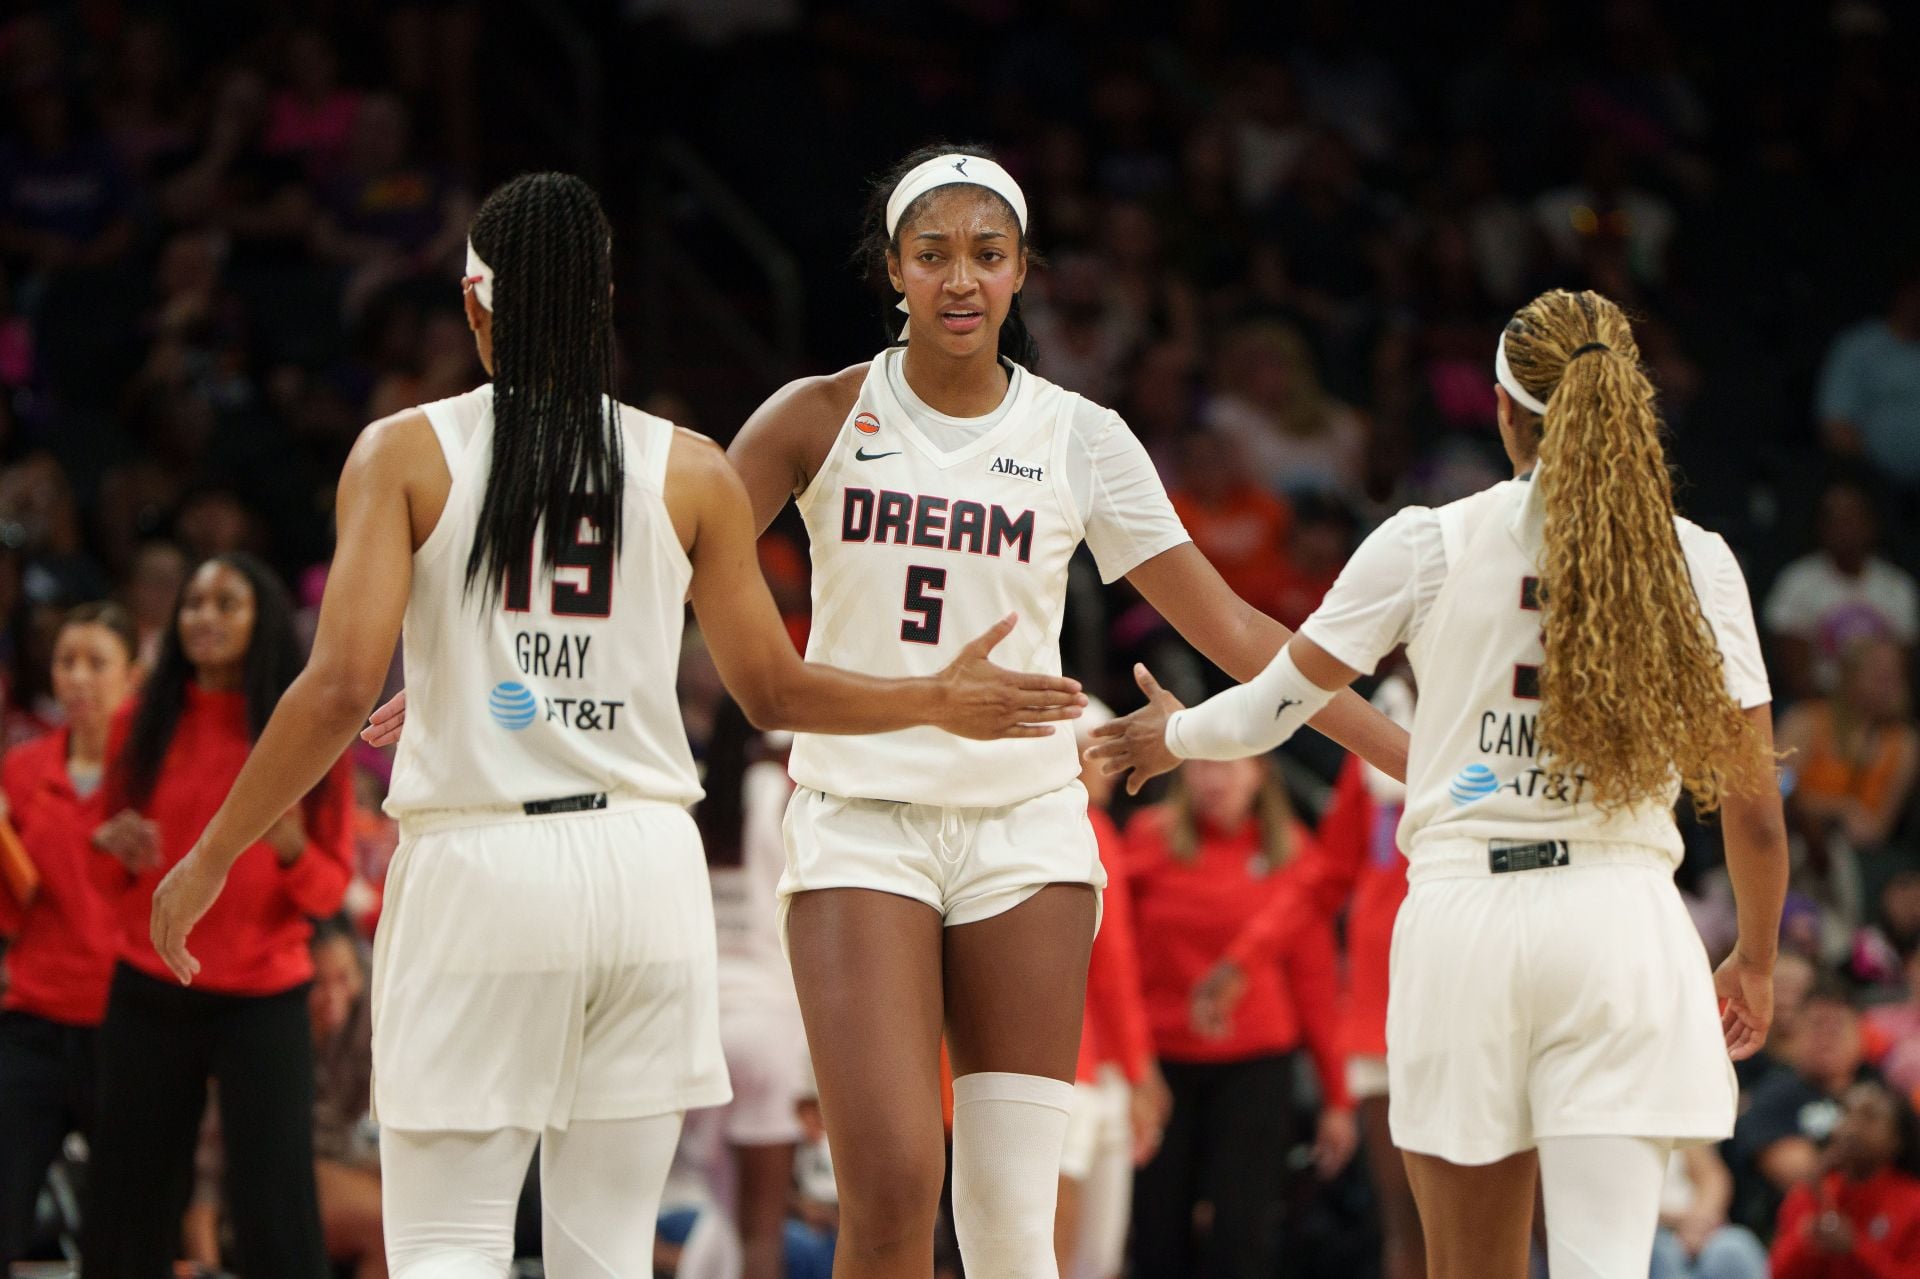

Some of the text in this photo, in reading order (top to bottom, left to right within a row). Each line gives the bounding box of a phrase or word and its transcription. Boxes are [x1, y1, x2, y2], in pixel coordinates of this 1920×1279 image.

[990, 457, 1043, 482] Albert
[841, 487, 1035, 564] DREAM
[901, 564, 946, 646] 5
[516, 630, 592, 679] GRAY
[1479, 710, 1554, 758] CAN
